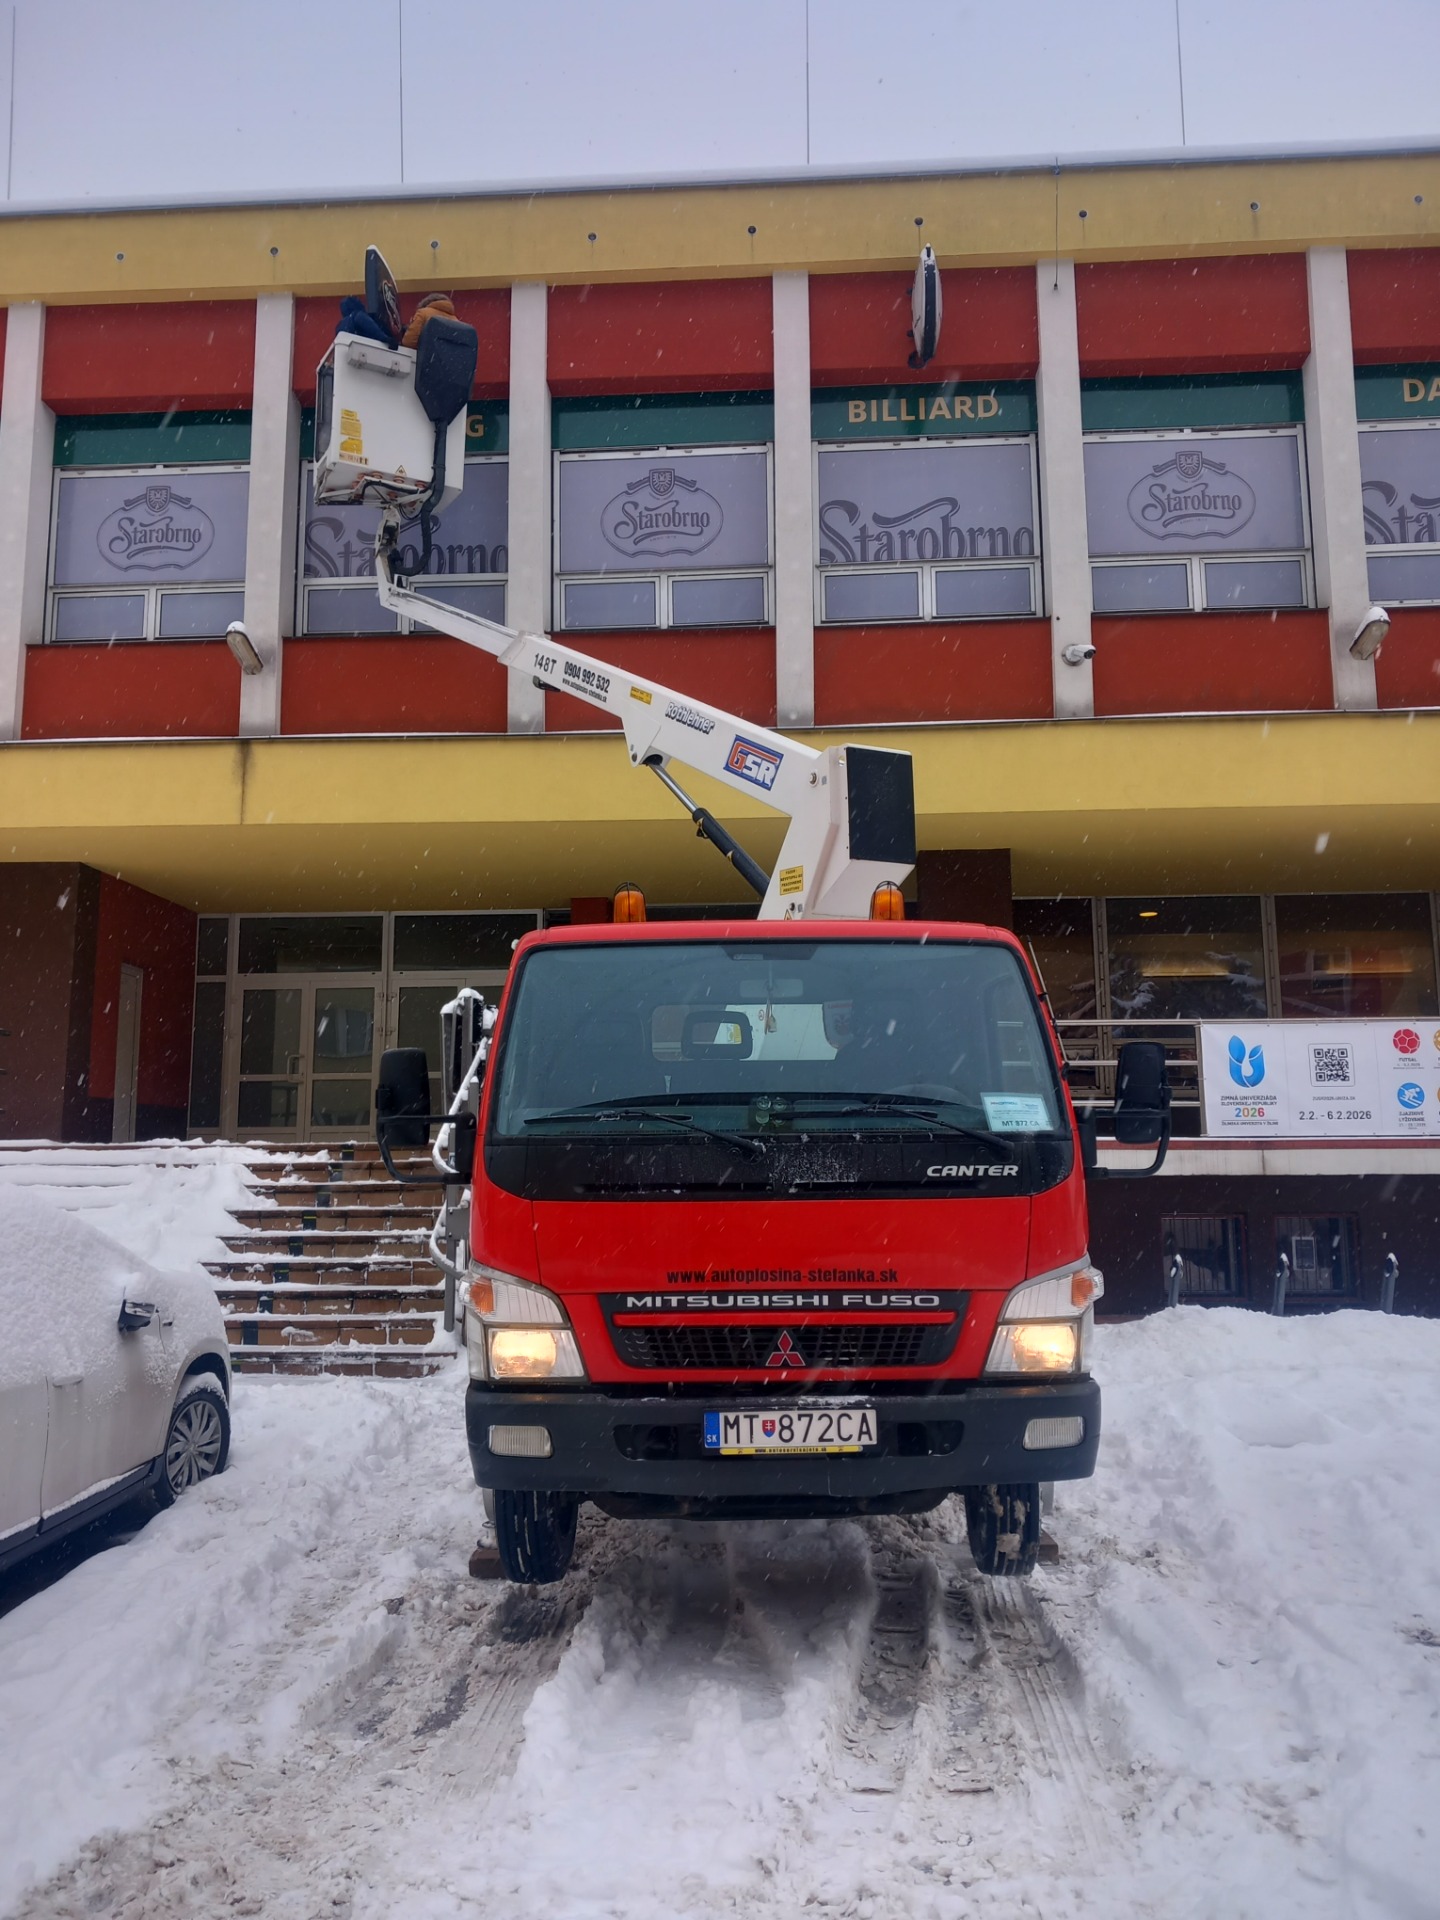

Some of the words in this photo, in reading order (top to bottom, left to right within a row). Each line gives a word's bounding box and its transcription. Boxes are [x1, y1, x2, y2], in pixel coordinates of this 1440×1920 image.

[848, 395, 999, 423] BILLIARD
[1141, 483, 1242, 528] Starobrno
[613, 500, 710, 545] Starobrno
[109, 516, 202, 560] Starobrno
[534, 653, 557, 674] 148T
[564, 661, 581, 680] 0904
[582, 669, 596, 687] 992
[596, 675, 611, 693] 532
[665, 702, 715, 735] Rothlehner
[728, 740, 780, 787] GSR
[1235, 1107, 1265, 1117] 2026
[1299, 1111, 1318, 1120] 2.2.
[1327, 1110, 1372, 1120] 6.2.2026
[926, 1165, 1019, 1177] CANTER
[627, 1295, 829, 1308] MITSUBISHI
[842, 1295, 940, 1306] FUSO
[706, 1434, 718, 1443] SK
[723, 1415, 759, 1444] MT
[778, 1413, 873, 1443] 872CA
